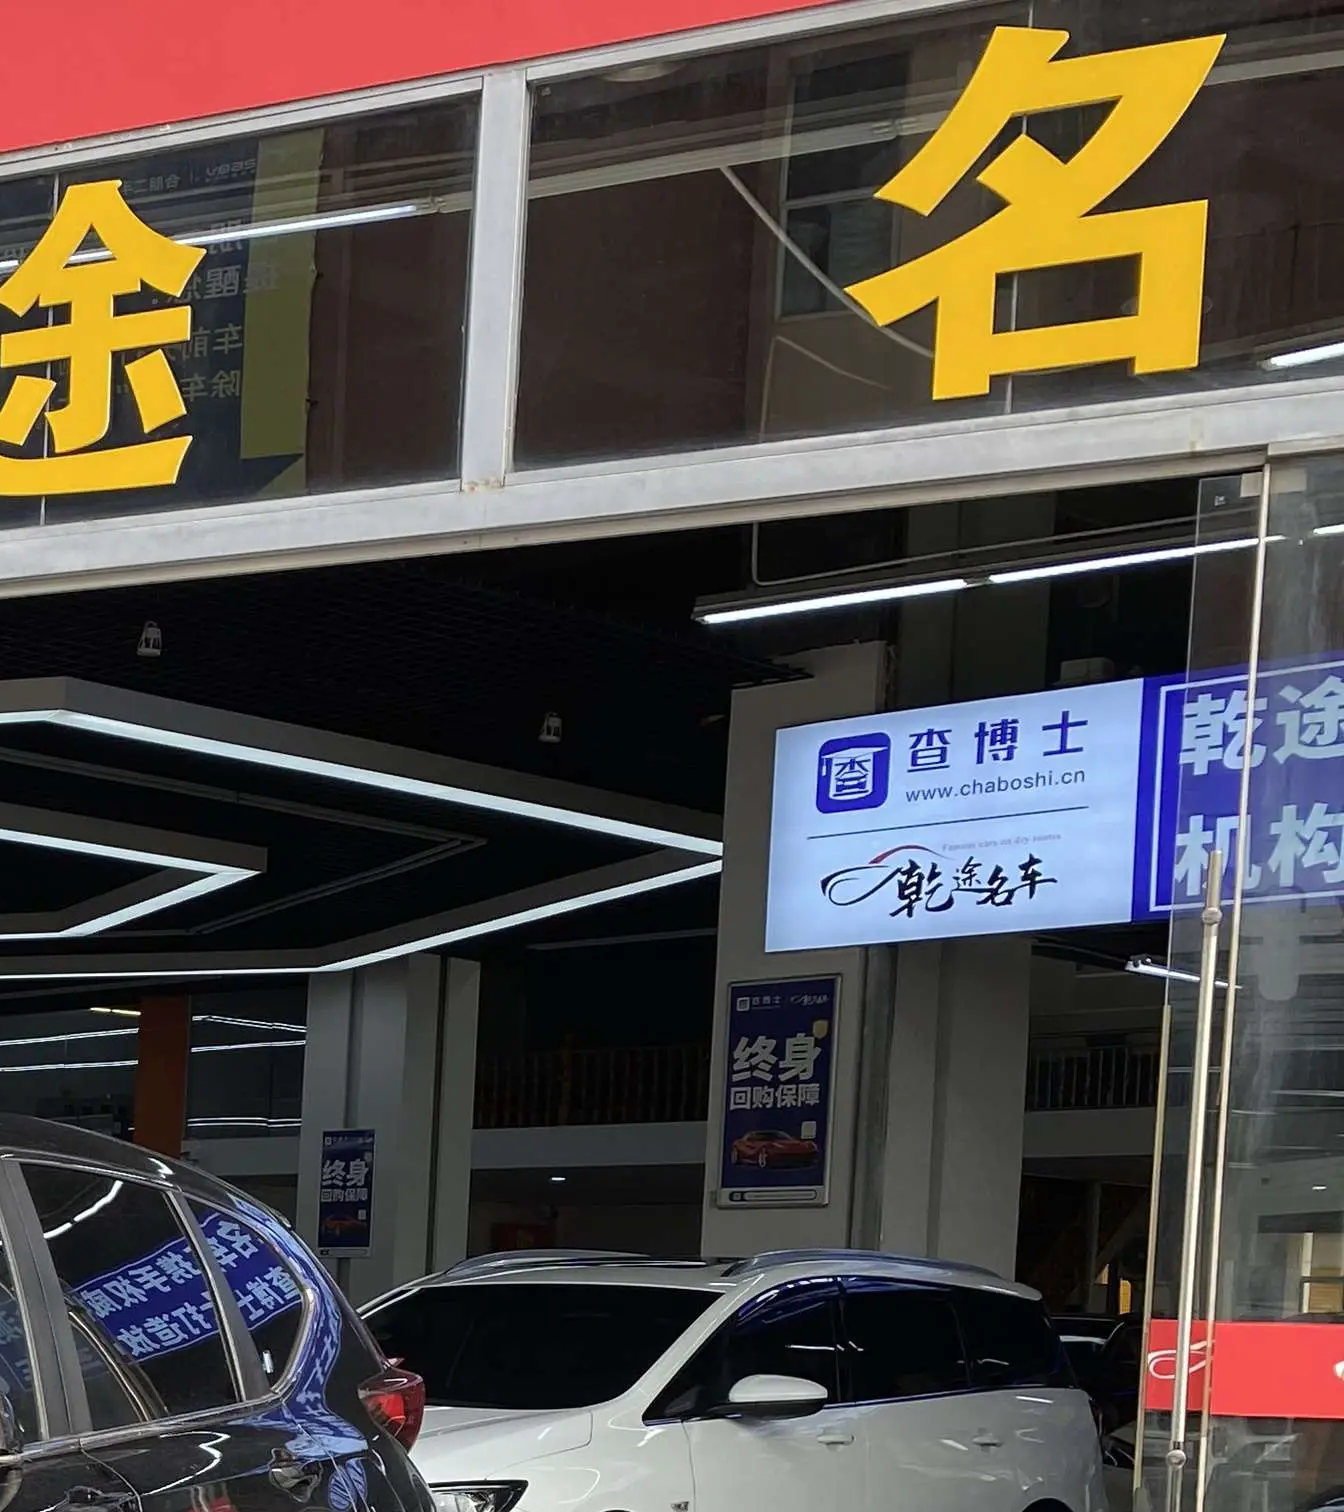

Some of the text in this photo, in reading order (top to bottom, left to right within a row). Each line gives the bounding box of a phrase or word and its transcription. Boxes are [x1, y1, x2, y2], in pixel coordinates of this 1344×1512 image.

[906, 709, 1089, 774] 查博士
[905, 769, 1086, 803] www.chaboshi.cn
[889, 852, 1058, 918] 乾途名车
[731, 1031, 822, 1083] 终身
[729, 1082, 821, 1111] 回购保障
[321, 1158, 369, 1187] 终身
